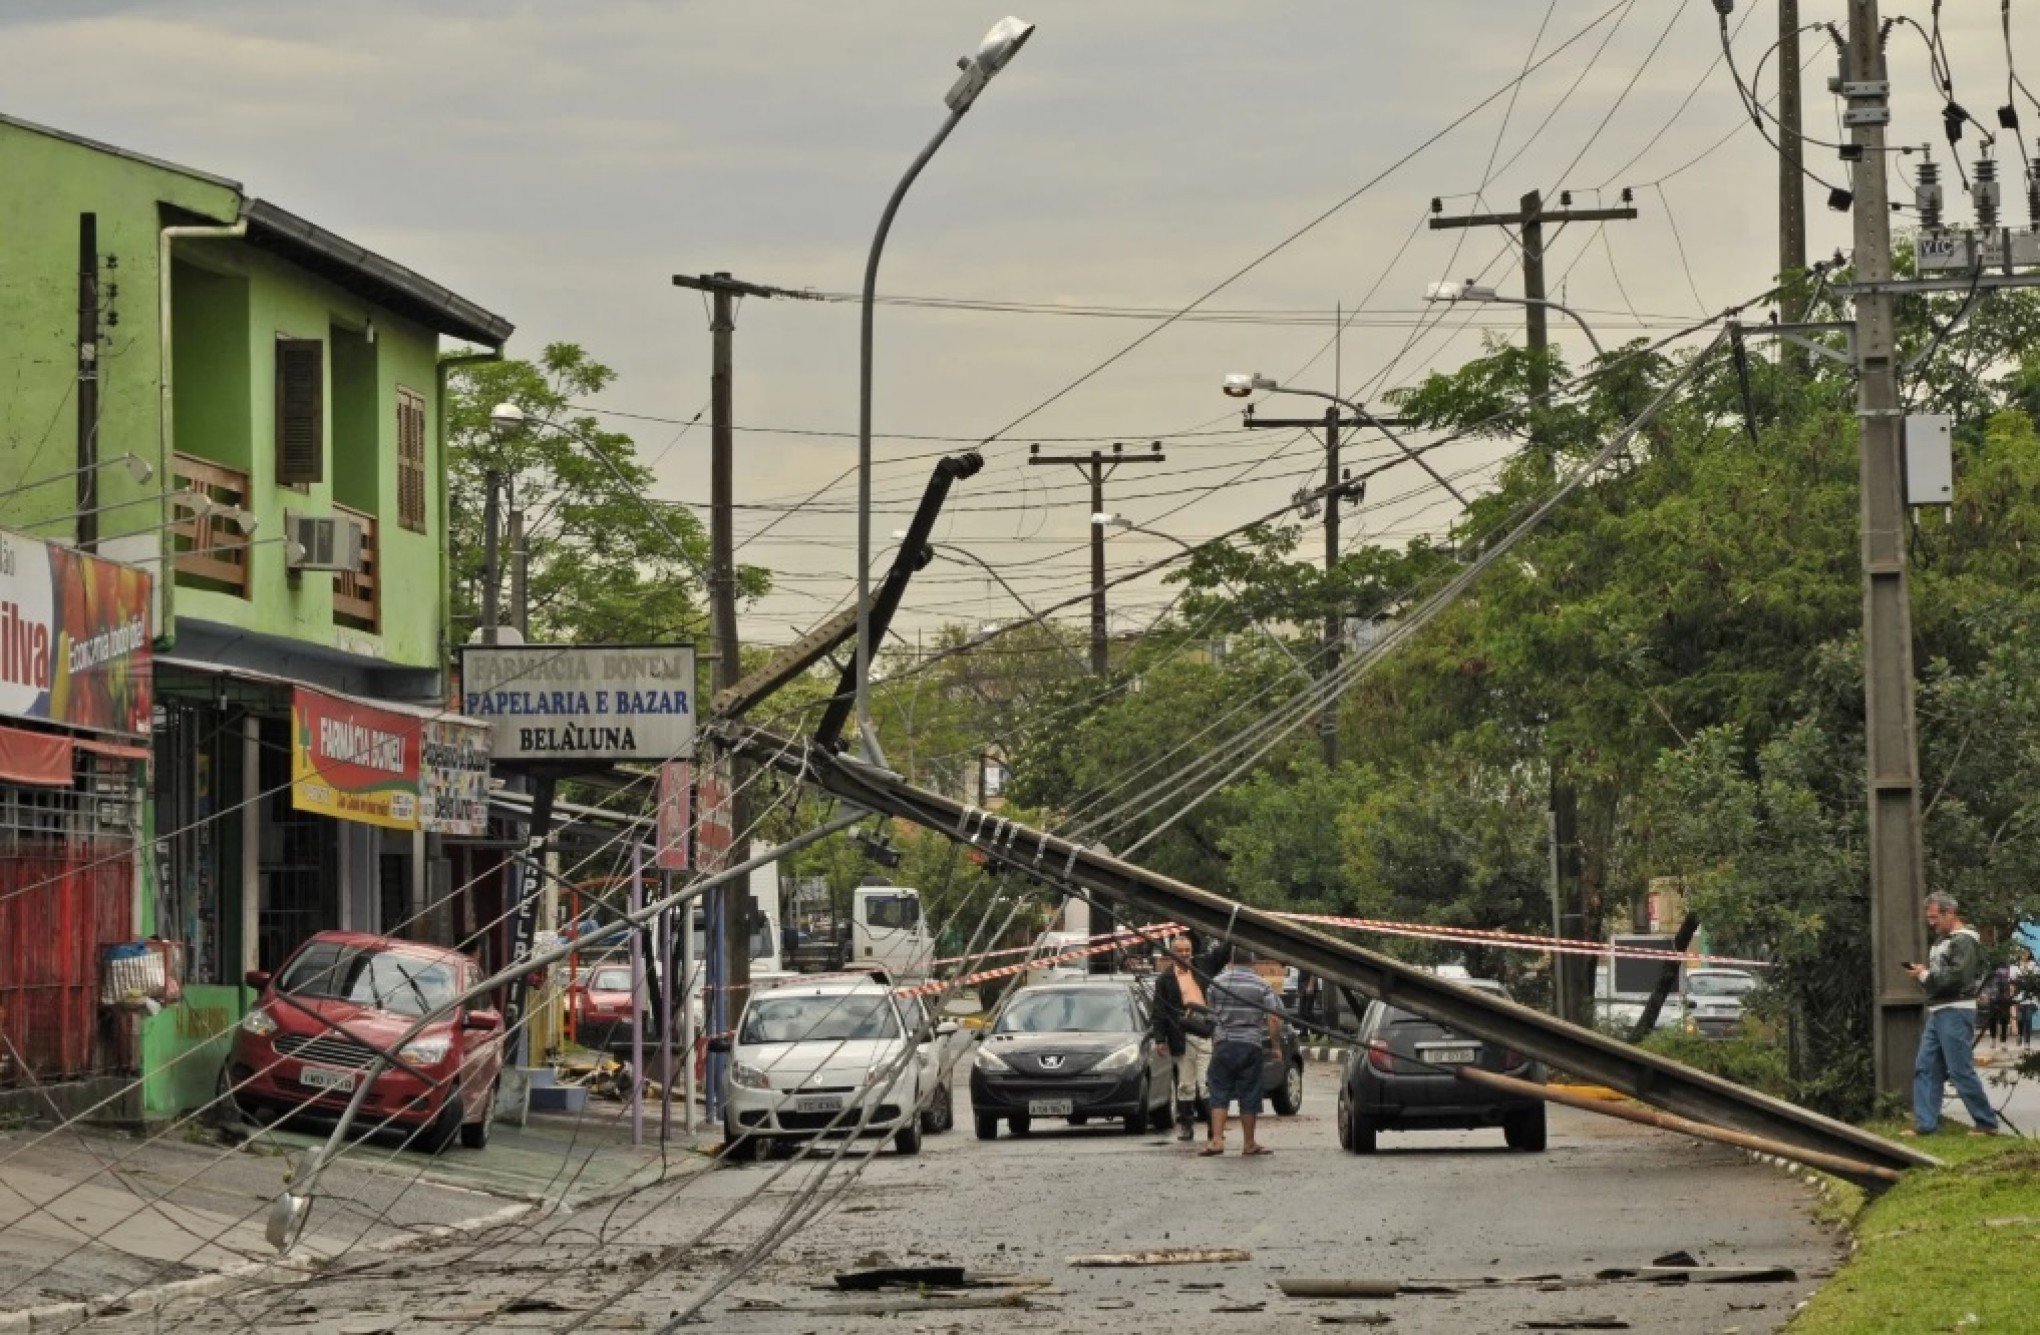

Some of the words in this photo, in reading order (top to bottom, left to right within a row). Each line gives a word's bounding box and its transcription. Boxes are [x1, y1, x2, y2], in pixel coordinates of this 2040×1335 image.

[0, 539, 16, 576] ão
[466, 690, 590, 715] PAPELARIA
[595, 691, 608, 715] E
[615, 690, 689, 715] BAZAR
[320, 714, 370, 767] FARMÁCIA
